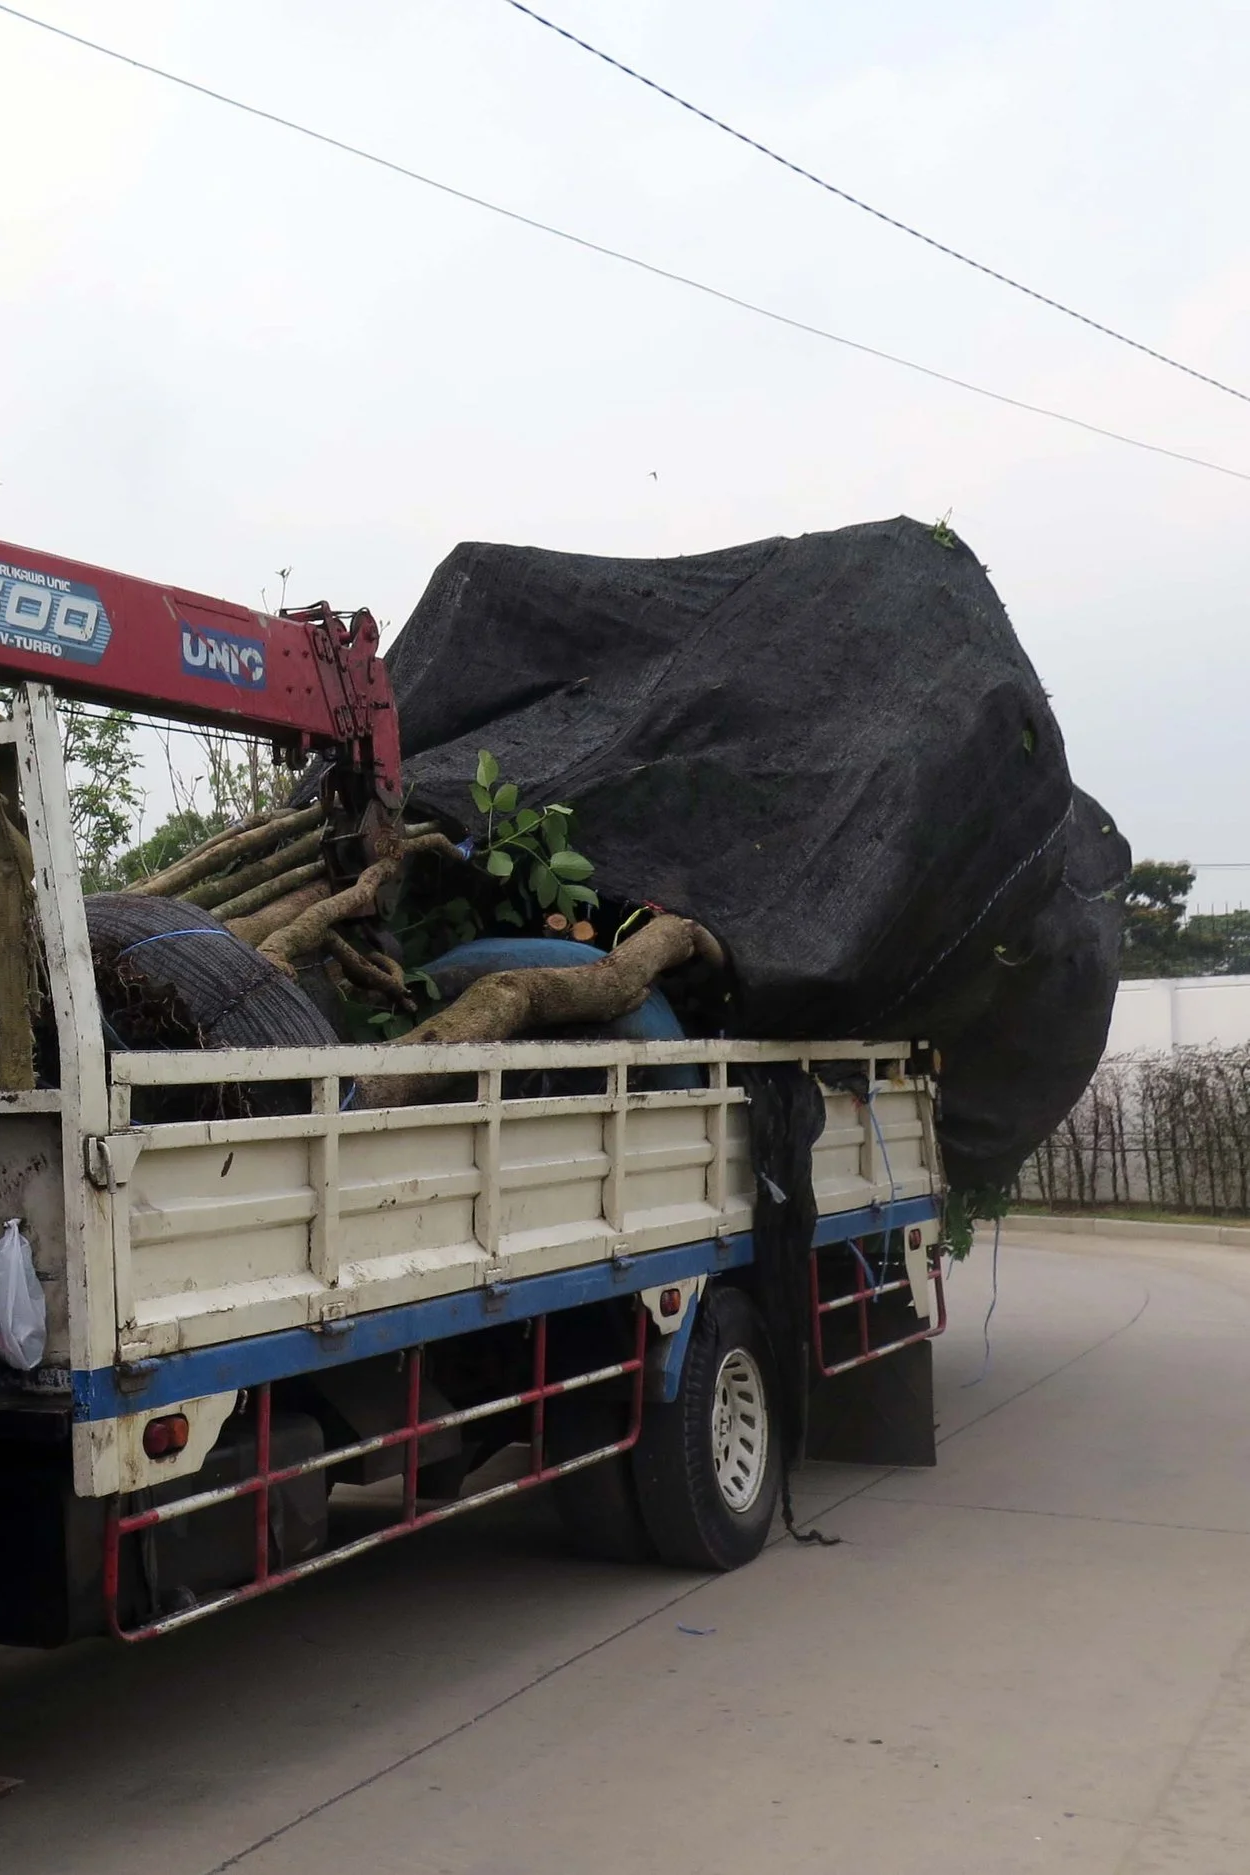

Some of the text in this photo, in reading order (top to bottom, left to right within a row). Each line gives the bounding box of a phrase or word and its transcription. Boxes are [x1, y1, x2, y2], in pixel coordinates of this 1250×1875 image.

[47, 578, 71, 593] UNIC
[0, 631, 63, 657] V-TURBO
[182, 631, 264, 681] UNIC
